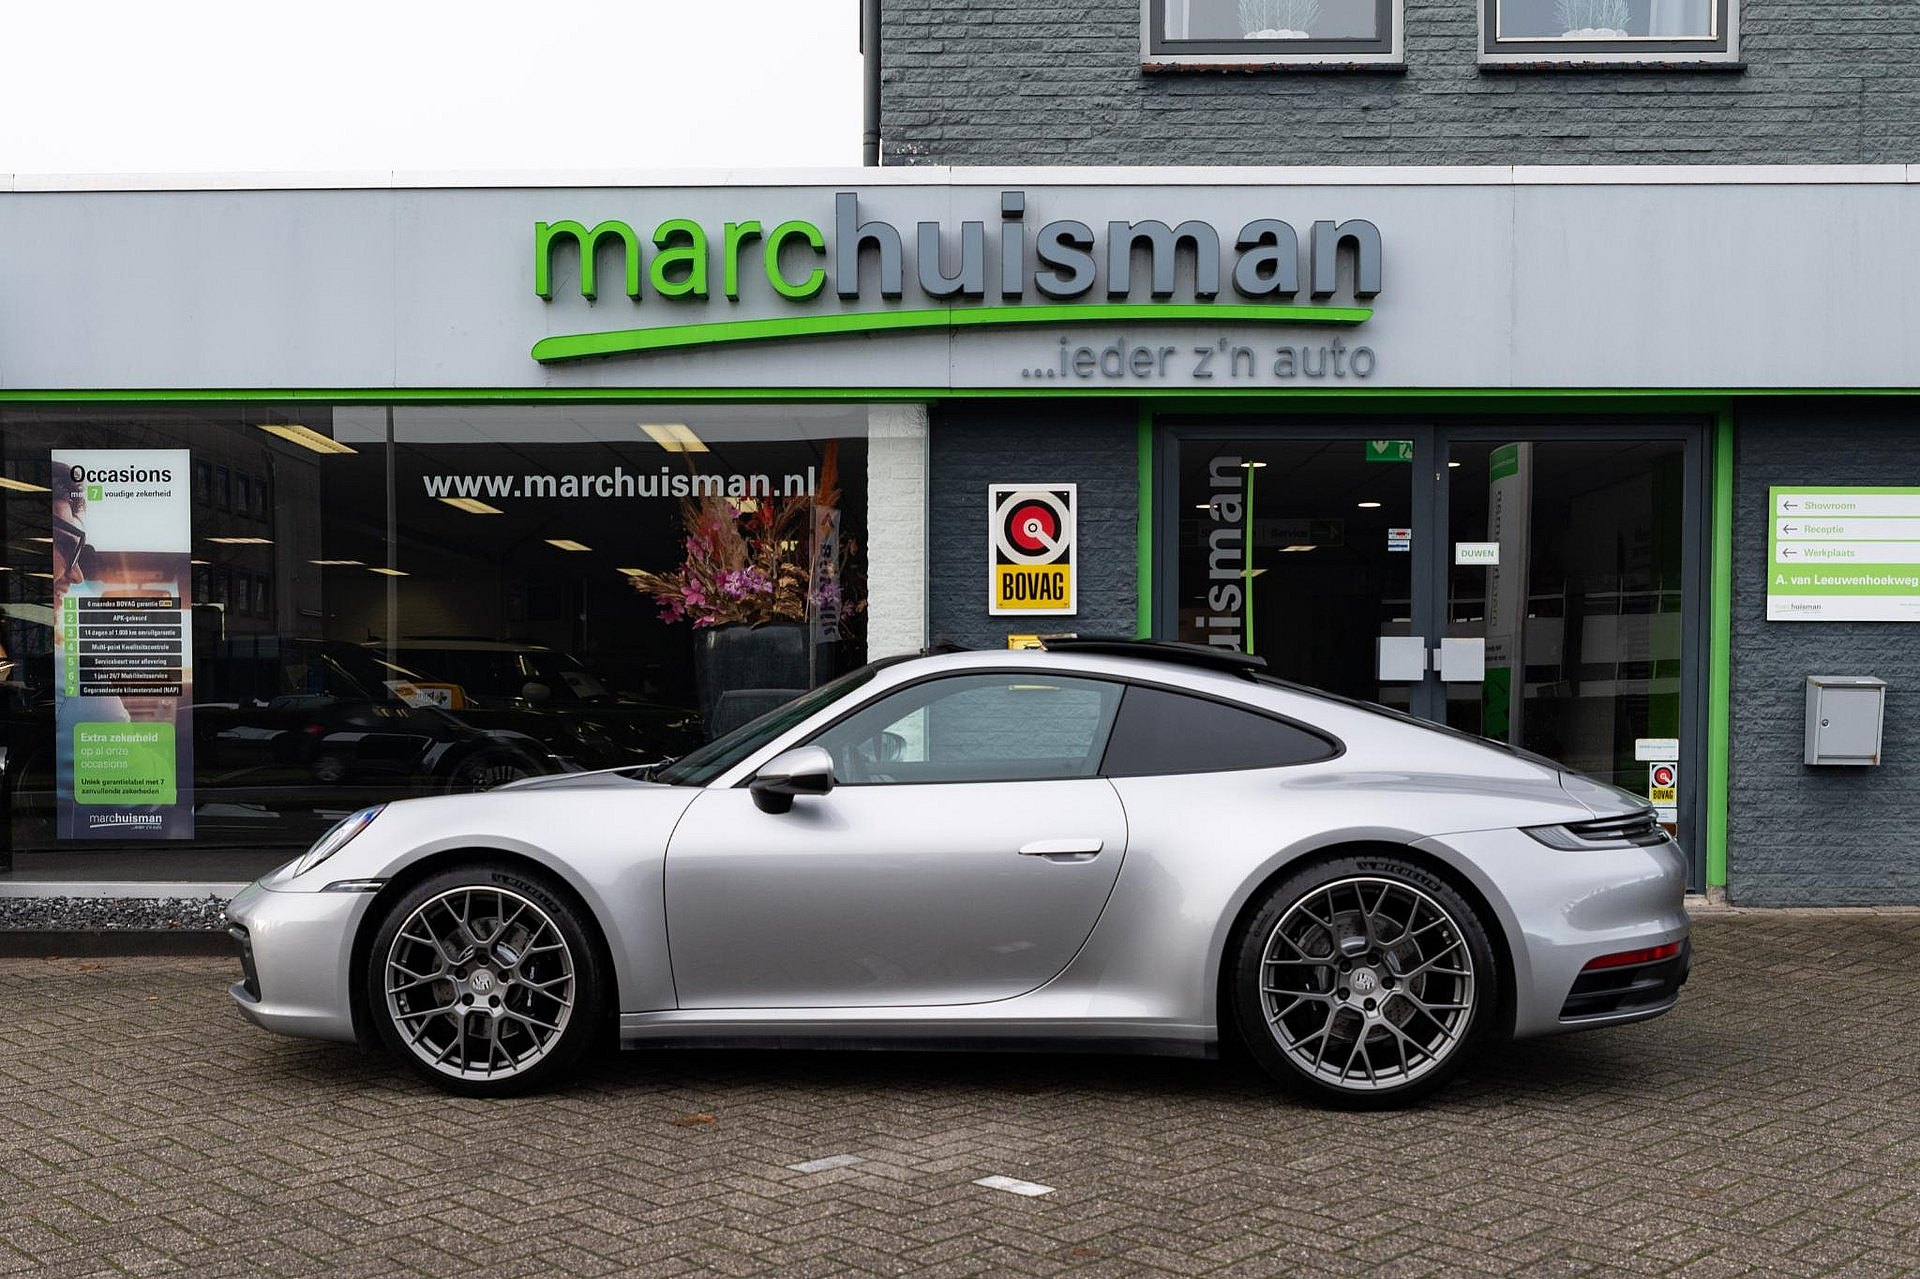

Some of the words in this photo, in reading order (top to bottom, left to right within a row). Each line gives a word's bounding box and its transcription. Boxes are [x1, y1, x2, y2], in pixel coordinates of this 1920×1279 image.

[535, 192, 1382, 301] marchuisman
[1192, 337, 1256, 377] z'n
[1273, 336, 1376, 378] auto
[70, 465, 171, 483] Occasions
[422, 466, 816, 498] www.marchuisman.nl
[105, 490, 134, 499] voudige
[1804, 501, 1856, 510] Showroom
[1804, 524, 1844, 534] Receptie
[1461, 550, 1494, 558] DUWEN
[1804, 548, 1855, 559] Werkplaats
[1775, 574, 1788, 585] A.
[1791, 576, 1810, 585] van
[1814, 574, 1919, 587] Leeuwenhoekweg
[1002, 572, 1064, 600] BOVAG
[80, 733, 107, 742] Extra
[110, 733, 158, 742] zekerheid
[80, 748, 93, 756] op
[95, 747, 104, 755] al
[80, 761, 128, 769] occasions
[1653, 790, 1674, 800] BOVAG
[89, 813, 162, 823] marchuisman
[1376, 862, 1441, 891] MICHELIN
